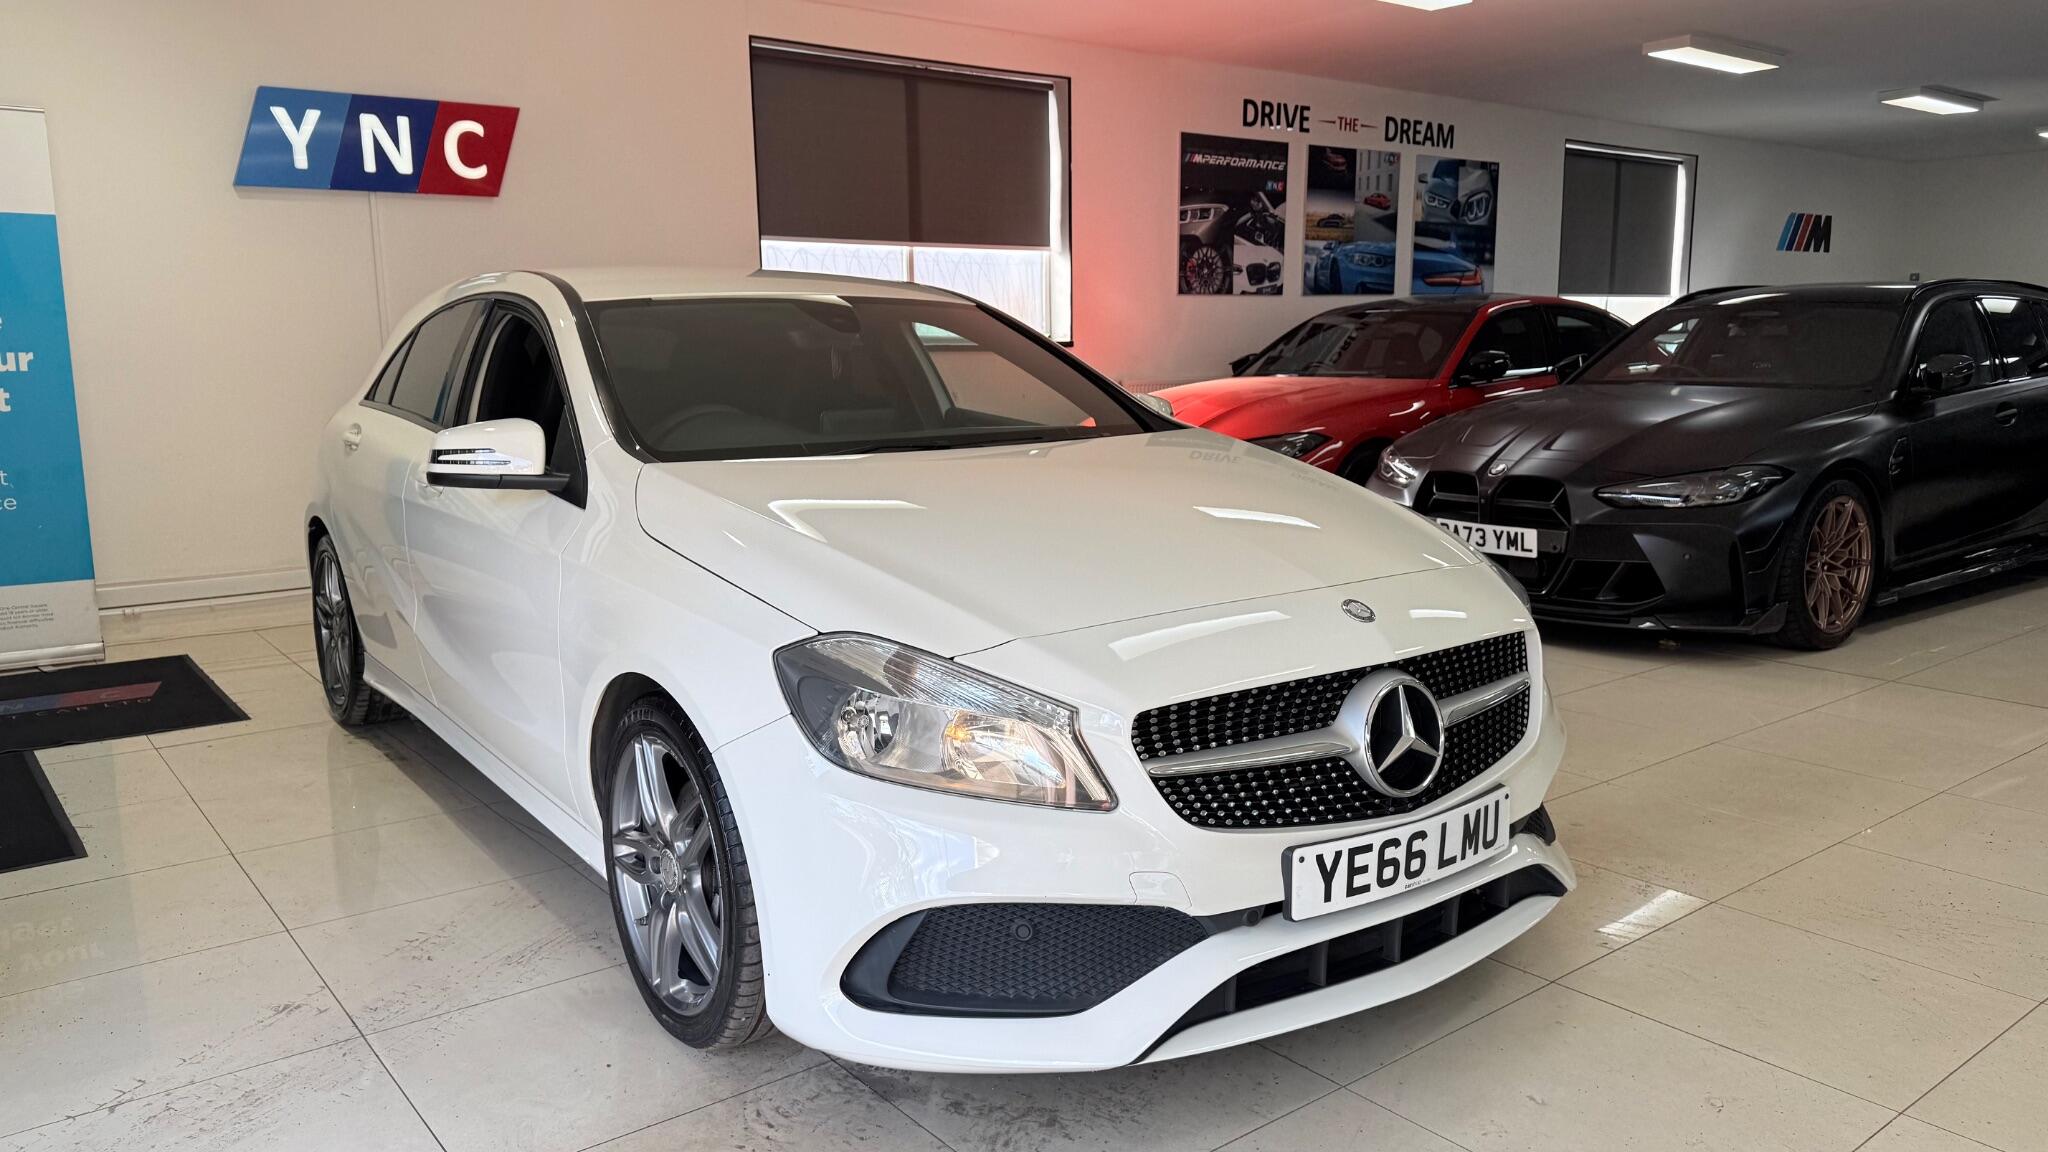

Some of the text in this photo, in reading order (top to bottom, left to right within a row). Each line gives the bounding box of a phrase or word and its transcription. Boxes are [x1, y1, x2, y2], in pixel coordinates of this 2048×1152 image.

[269, 105, 489, 180] YNC
[1242, 98, 1455, 149] DRIVE THE DREAM
[1492, 528, 1533, 553] YML
[1315, 799, 1500, 904] YE66 LMU
